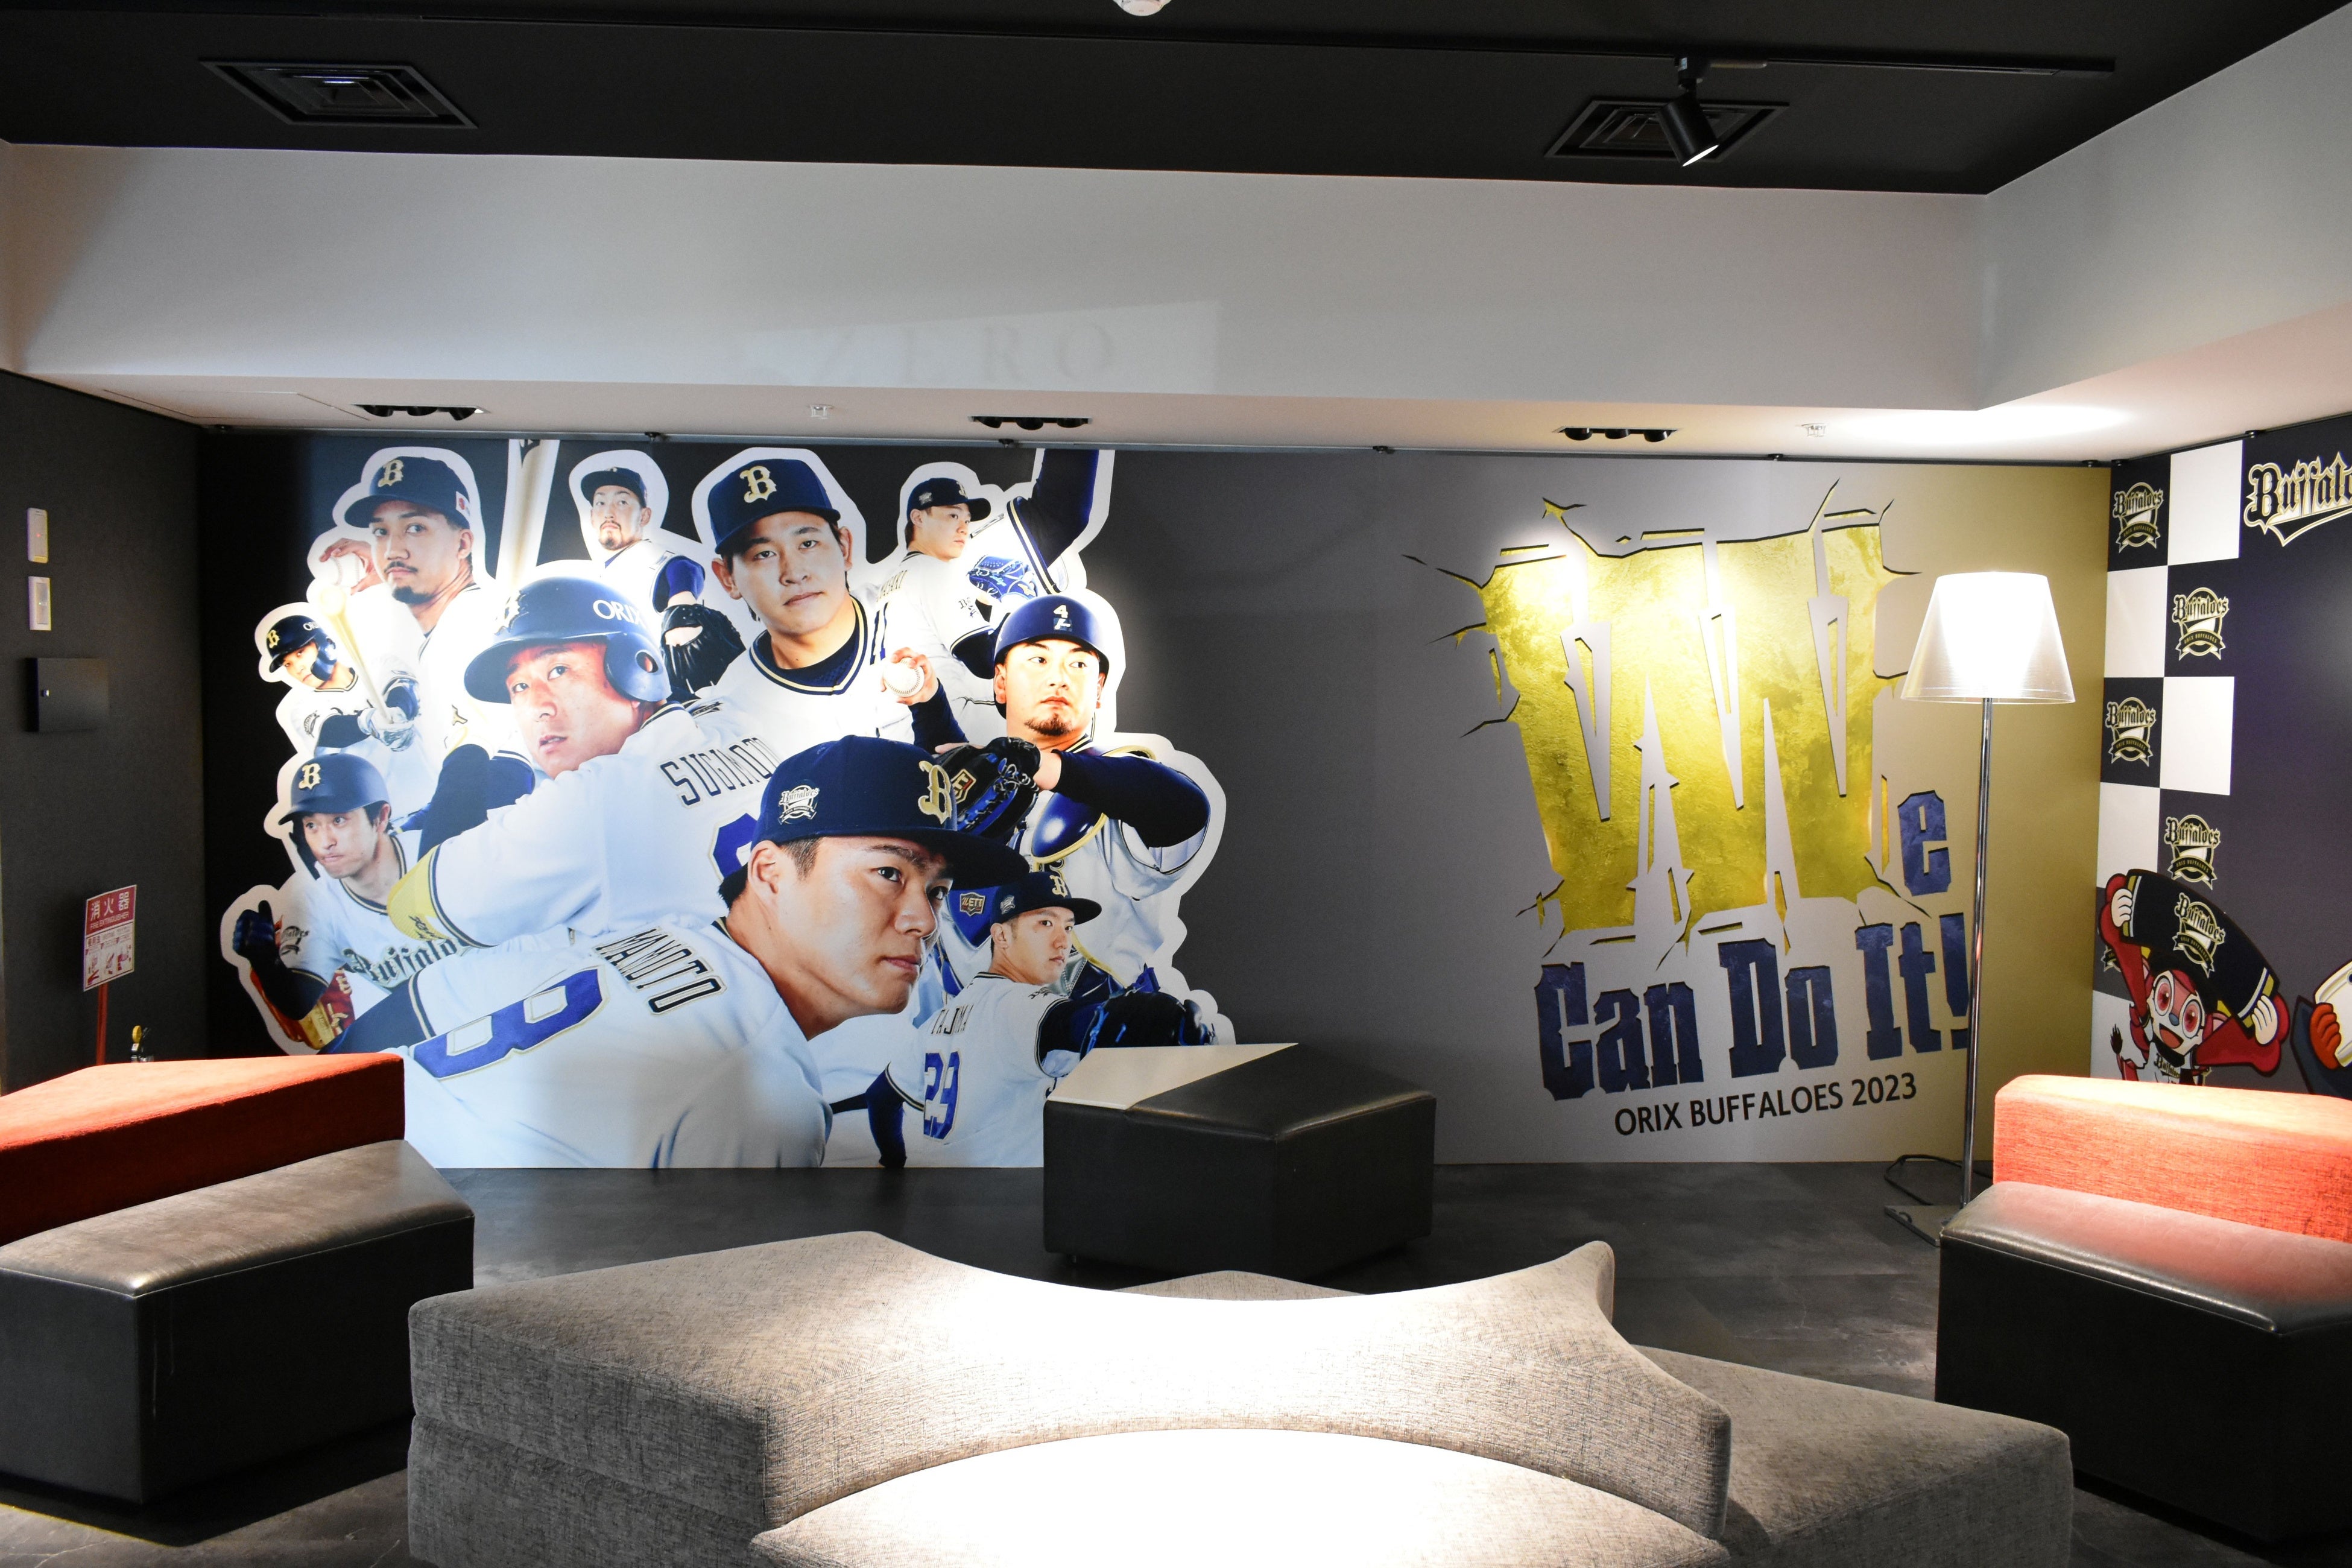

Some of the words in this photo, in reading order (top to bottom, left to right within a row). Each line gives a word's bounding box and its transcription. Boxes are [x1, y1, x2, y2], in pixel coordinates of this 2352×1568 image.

[378, 460, 403, 487] B
[739, 466, 777, 503] B
[2113, 489, 2164, 518] Buffaloes
[2172, 595, 2230, 623] Buffaloes
[267, 629, 280, 649] B
[2105, 701, 2156, 728] Buffaloes
[299, 763, 321, 790] B
[918, 760, 952, 825] B
[2164, 817, 2221, 849] Buffaloes
[1049, 875, 1068, 898] B
[91, 891, 130, 921] 消火器
[2175, 893, 2225, 944] Buffaloes
[1534, 961, 1704, 1102] Can
[1718, 937, 1839, 1079] Do
[1854, 912, 1970, 1062] It!
[923, 1051, 961, 1140] 29
[1614, 1102, 1684, 1137] ORIX
[1690, 1081, 1844, 1129] BUFFALOES
[1851, 1072, 1918, 1108] 2023
